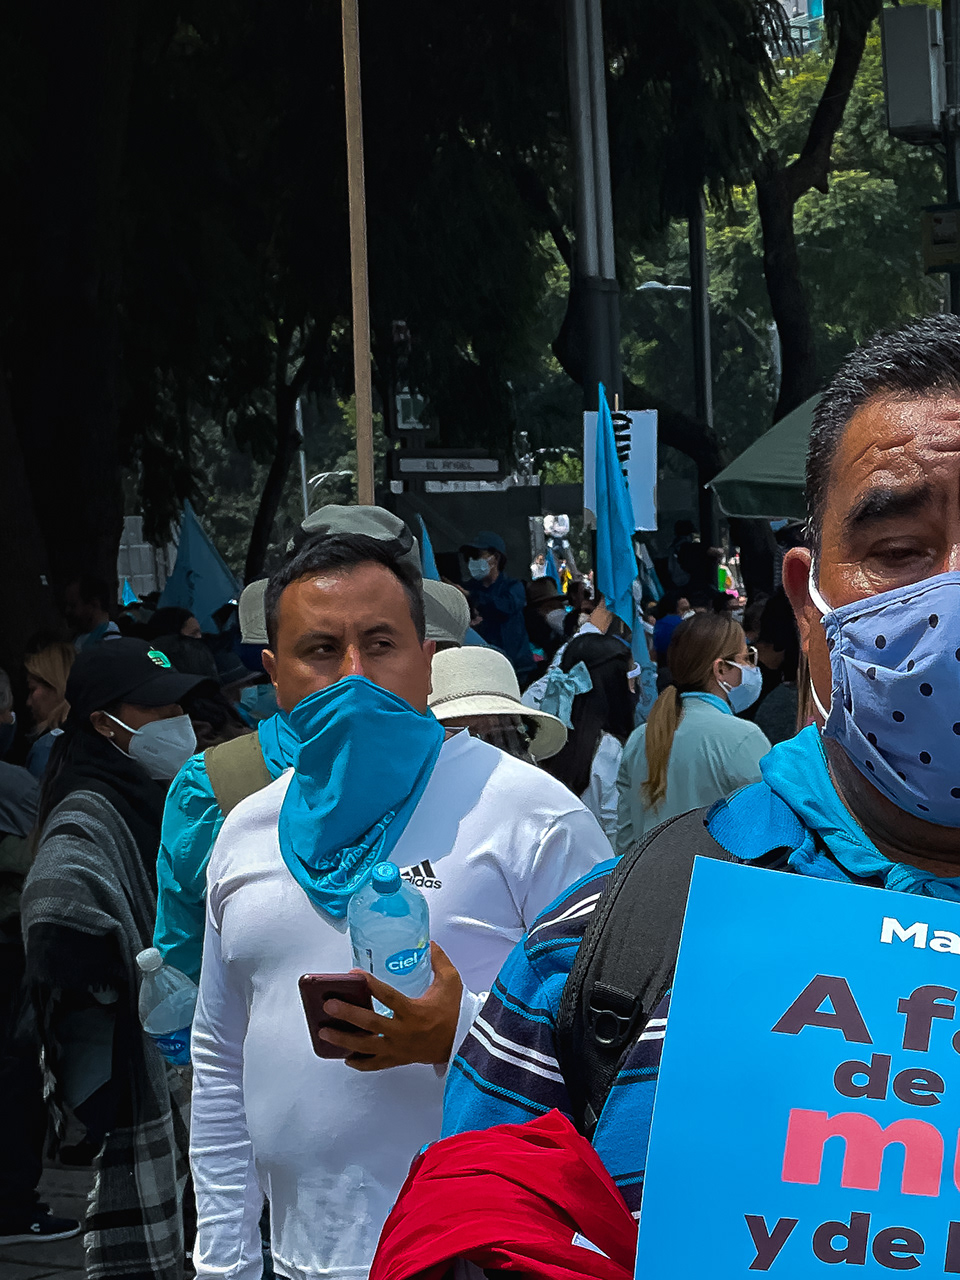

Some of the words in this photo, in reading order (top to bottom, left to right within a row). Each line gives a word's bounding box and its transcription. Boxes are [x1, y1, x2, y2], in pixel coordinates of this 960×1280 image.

[388, 951, 418, 970] ciel
[771, 974, 873, 1045] A
[833, 1053, 946, 1108] de
[744, 1213, 799, 1272] y
[811, 1211, 926, 1271] de
